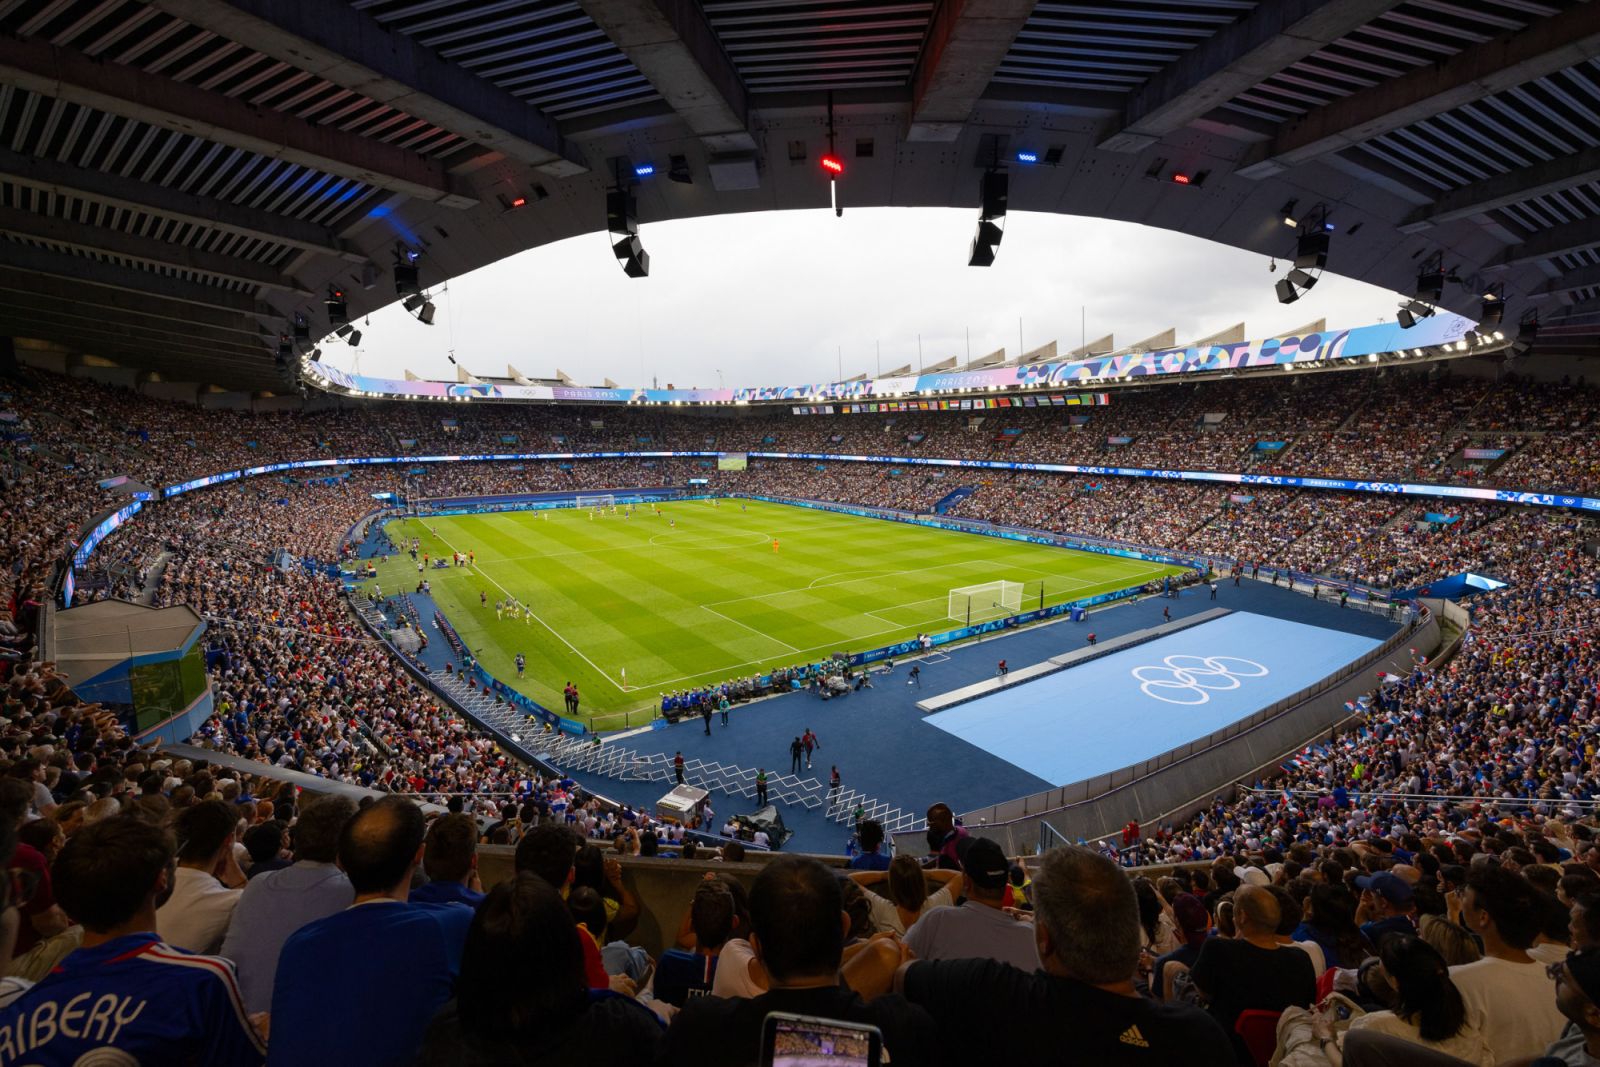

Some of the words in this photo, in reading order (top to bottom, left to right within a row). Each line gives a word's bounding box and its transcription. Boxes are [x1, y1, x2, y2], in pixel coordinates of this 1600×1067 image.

[934, 377, 963, 387] PARIS
[965, 375, 994, 385] 2024
[564, 390, 592, 398] PARIS
[0, 991, 147, 1065] RIBERY
